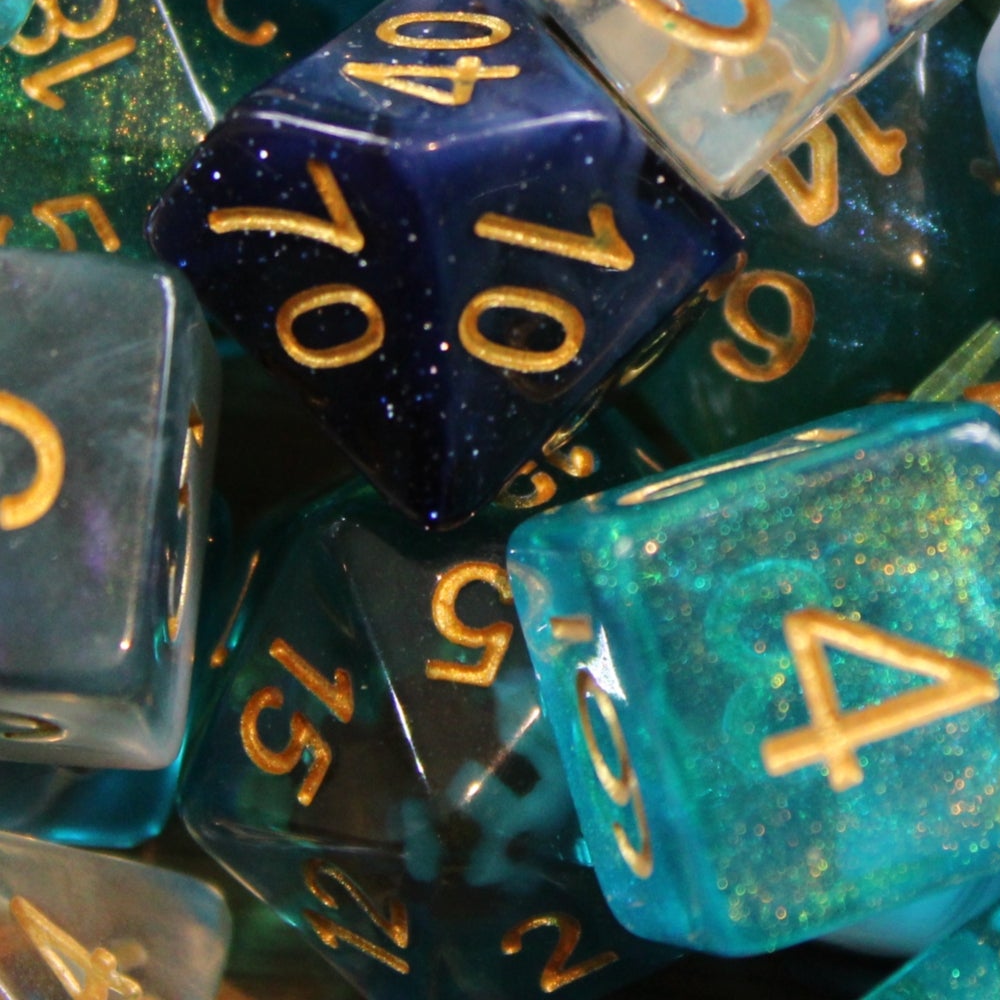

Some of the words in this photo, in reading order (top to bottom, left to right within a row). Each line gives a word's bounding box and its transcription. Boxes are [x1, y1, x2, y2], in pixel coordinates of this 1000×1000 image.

[341, 11, 521, 106] 40
[208, 160, 385, 370] 70
[458, 202, 636, 374] 10
[424, 560, 516, 688] 5
[239, 637, 356, 807] 15
[759, 607, 1000, 794] 4
[303, 858, 411, 976] 12
[501, 911, 620, 994] 2
